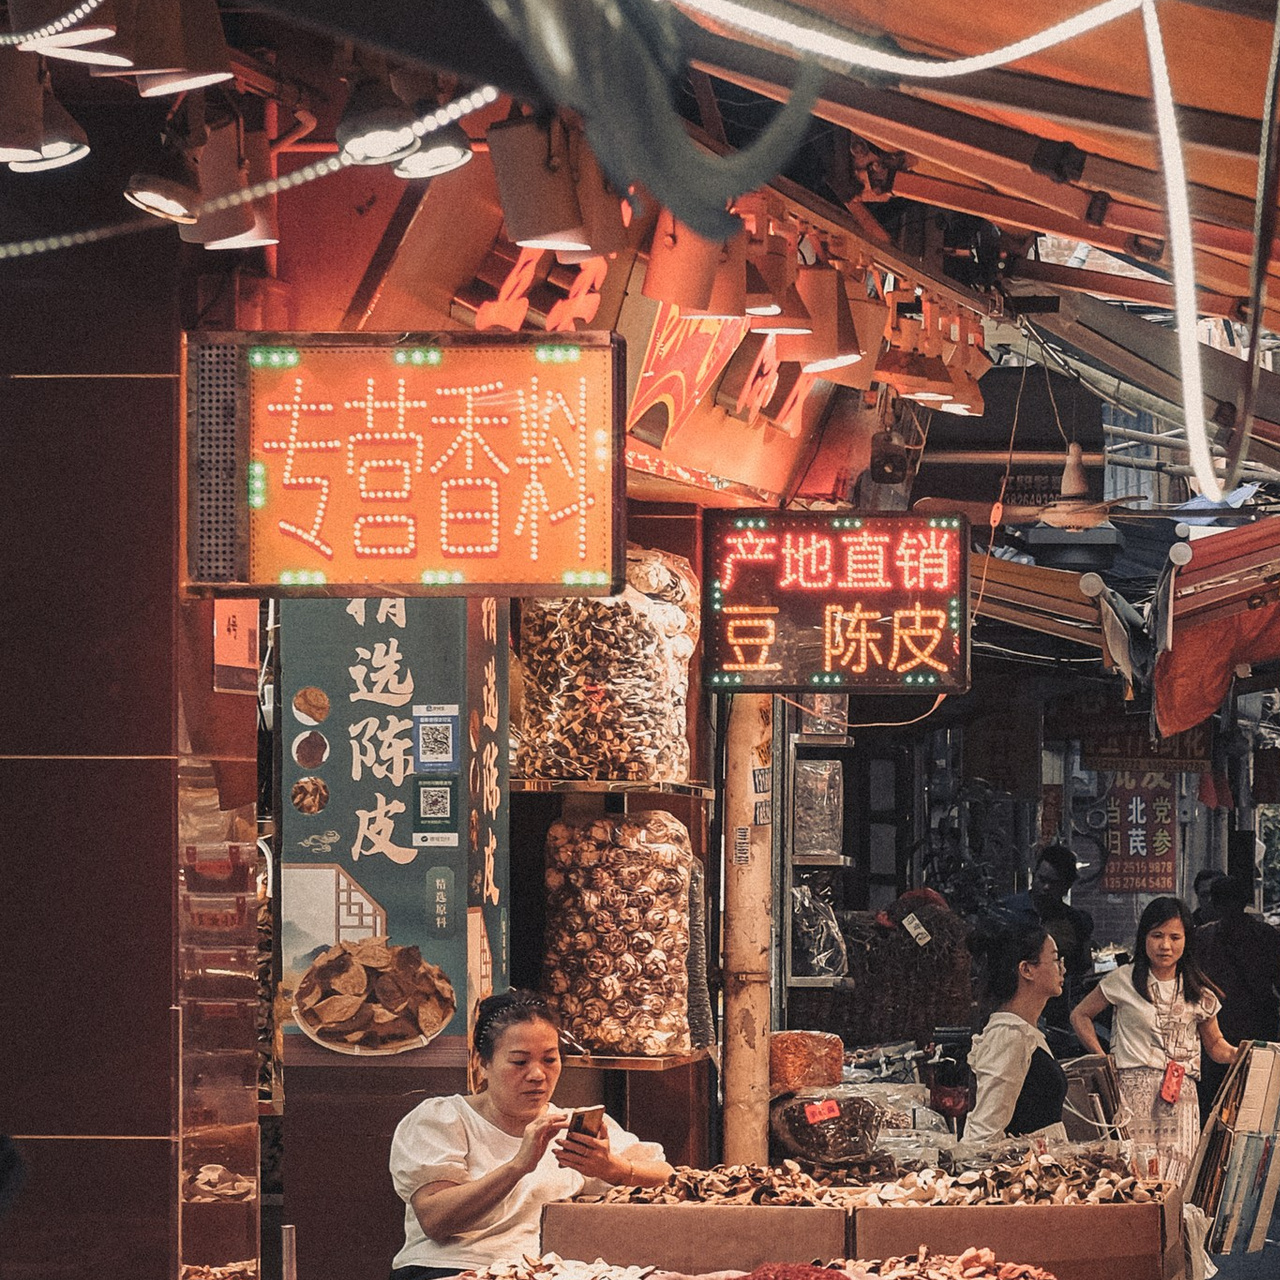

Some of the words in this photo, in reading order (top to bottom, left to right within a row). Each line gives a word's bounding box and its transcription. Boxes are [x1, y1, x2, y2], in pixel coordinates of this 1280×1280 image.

[262, 376, 595, 562] 专营香料
[720, 530, 951, 591] 产地直销
[722, 605, 783, 672] 豆
[823, 601, 950, 674] 陈皮
[1152, 796, 1173, 857] 党参
